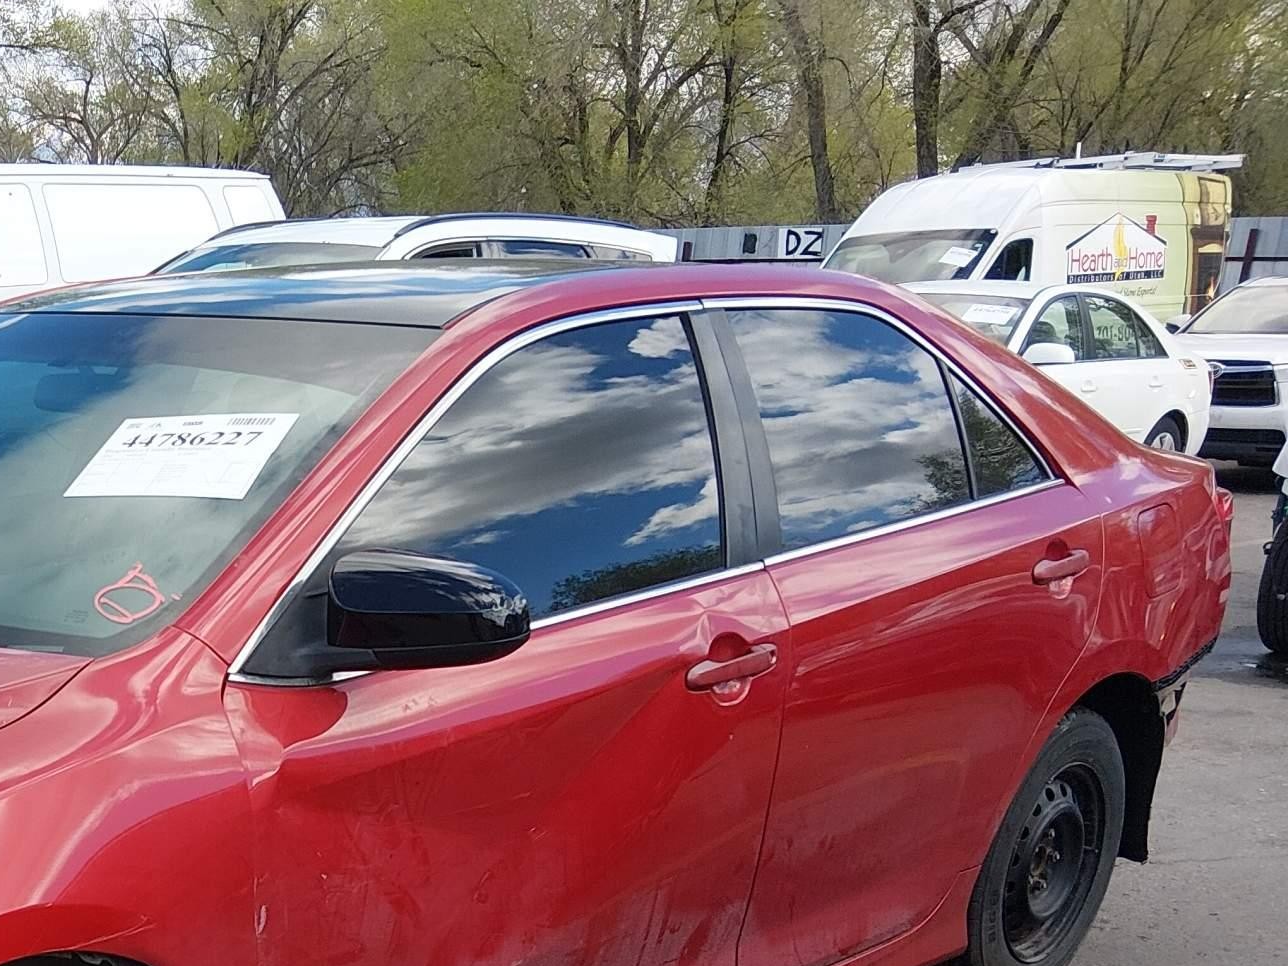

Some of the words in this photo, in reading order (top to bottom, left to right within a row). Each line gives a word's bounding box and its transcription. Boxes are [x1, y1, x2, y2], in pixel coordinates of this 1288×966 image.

[785, 229, 823, 256] DZ
[1071, 247, 1112, 272] Hearth
[1128, 247, 1163, 270] Home
[1069, 274, 1114, 284] Distributors
[1150, 270, 1162, 278] LLC
[121, 431, 263, 448] 44786227
